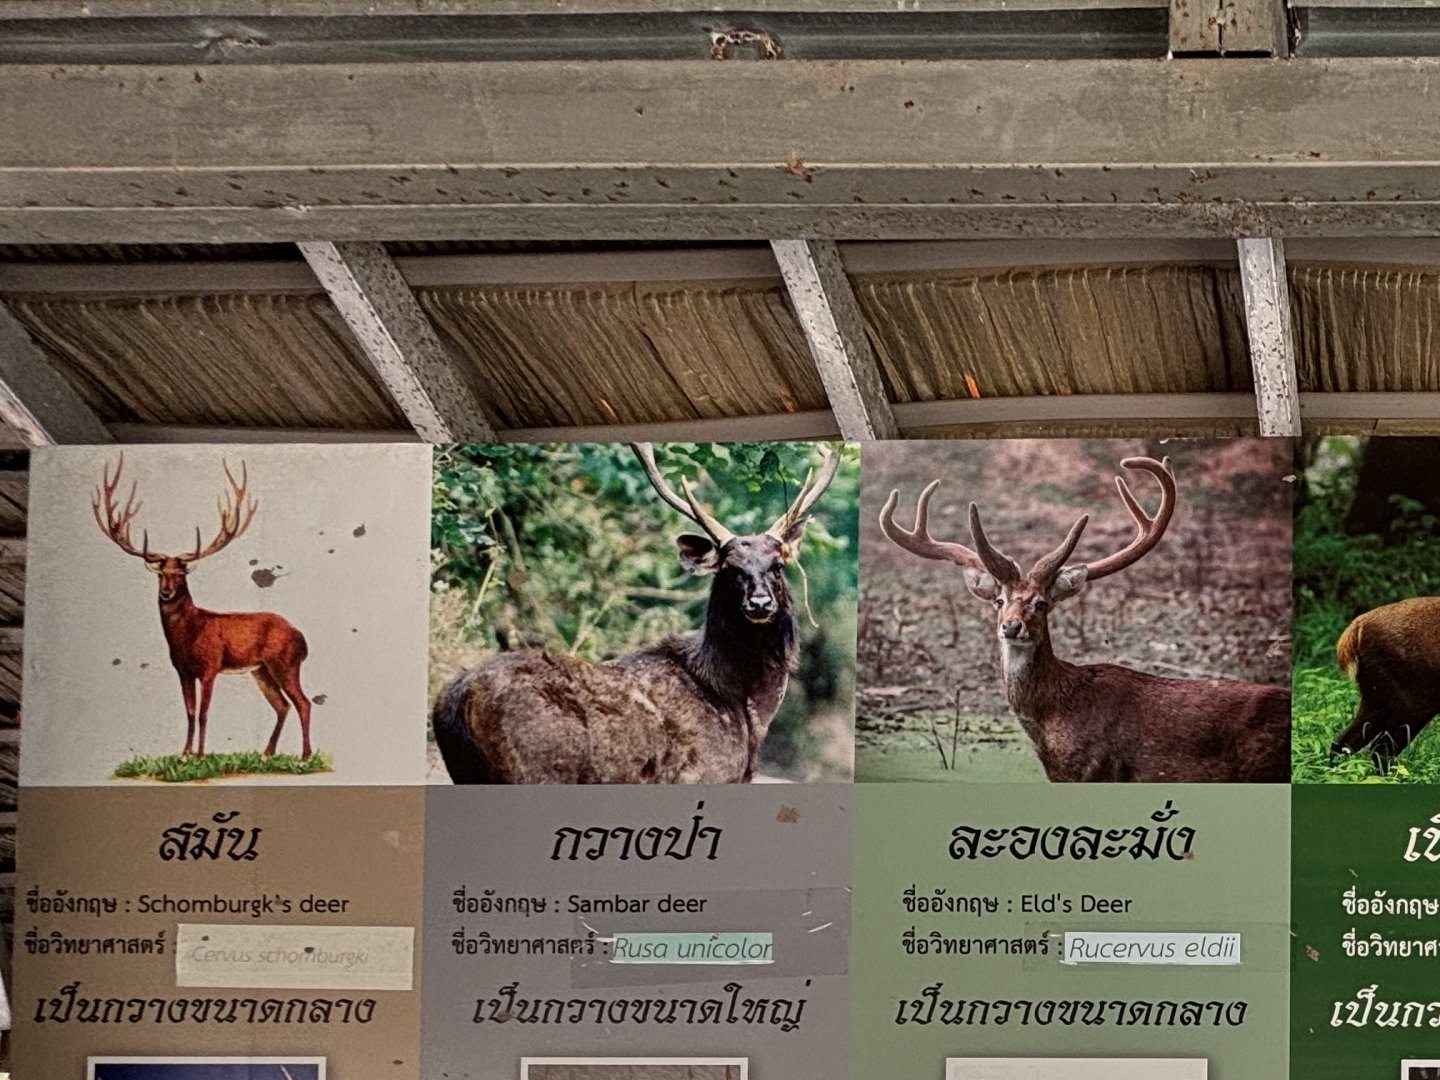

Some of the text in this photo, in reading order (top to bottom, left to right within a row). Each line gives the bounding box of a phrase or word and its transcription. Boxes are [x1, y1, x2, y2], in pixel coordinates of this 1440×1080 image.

[159, 811, 262, 861] สมัน
[550, 801, 722, 860] กวางป่า
[949, 800, 1196, 860] ละองละมั่ง
[26, 885, 117, 917] ชื่ออังกฤษ
[138, 894, 291, 918] Schomburgk's
[300, 894, 349, 913] deer
[453, 885, 547, 917] ชื่ออังกฤษ
[568, 895, 650, 913] Sambar
[658, 894, 707, 913] deer
[903, 884, 999, 917] ชื่ออังกฤษ
[1022, 893, 1072, 913] Eld's
[1082, 895, 1132, 913] Deer
[1343, 886, 1439, 919] ชื่ออังกฤษ
[24, 926, 165, 955] ชื่อวิทยาศาสตร์
[452, 926, 594, 955] ชื่อวิทยาศาสตร์
[613, 937, 668, 959] Rusa
[677, 937, 774, 959] unicolor
[902, 926, 1049, 955] ชื่อวิทยาศาสตร์
[1070, 938, 1175, 958] Rucervus
[1185, 936, 1235, 958] eldii
[33, 981, 376, 1024] เป็นกวางขนาดกลาง
[473, 980, 812, 1032] เป็นกวางขนาดใหญ่
[895, 983, 1247, 1026] เป็นกวางขนาดกลาง
